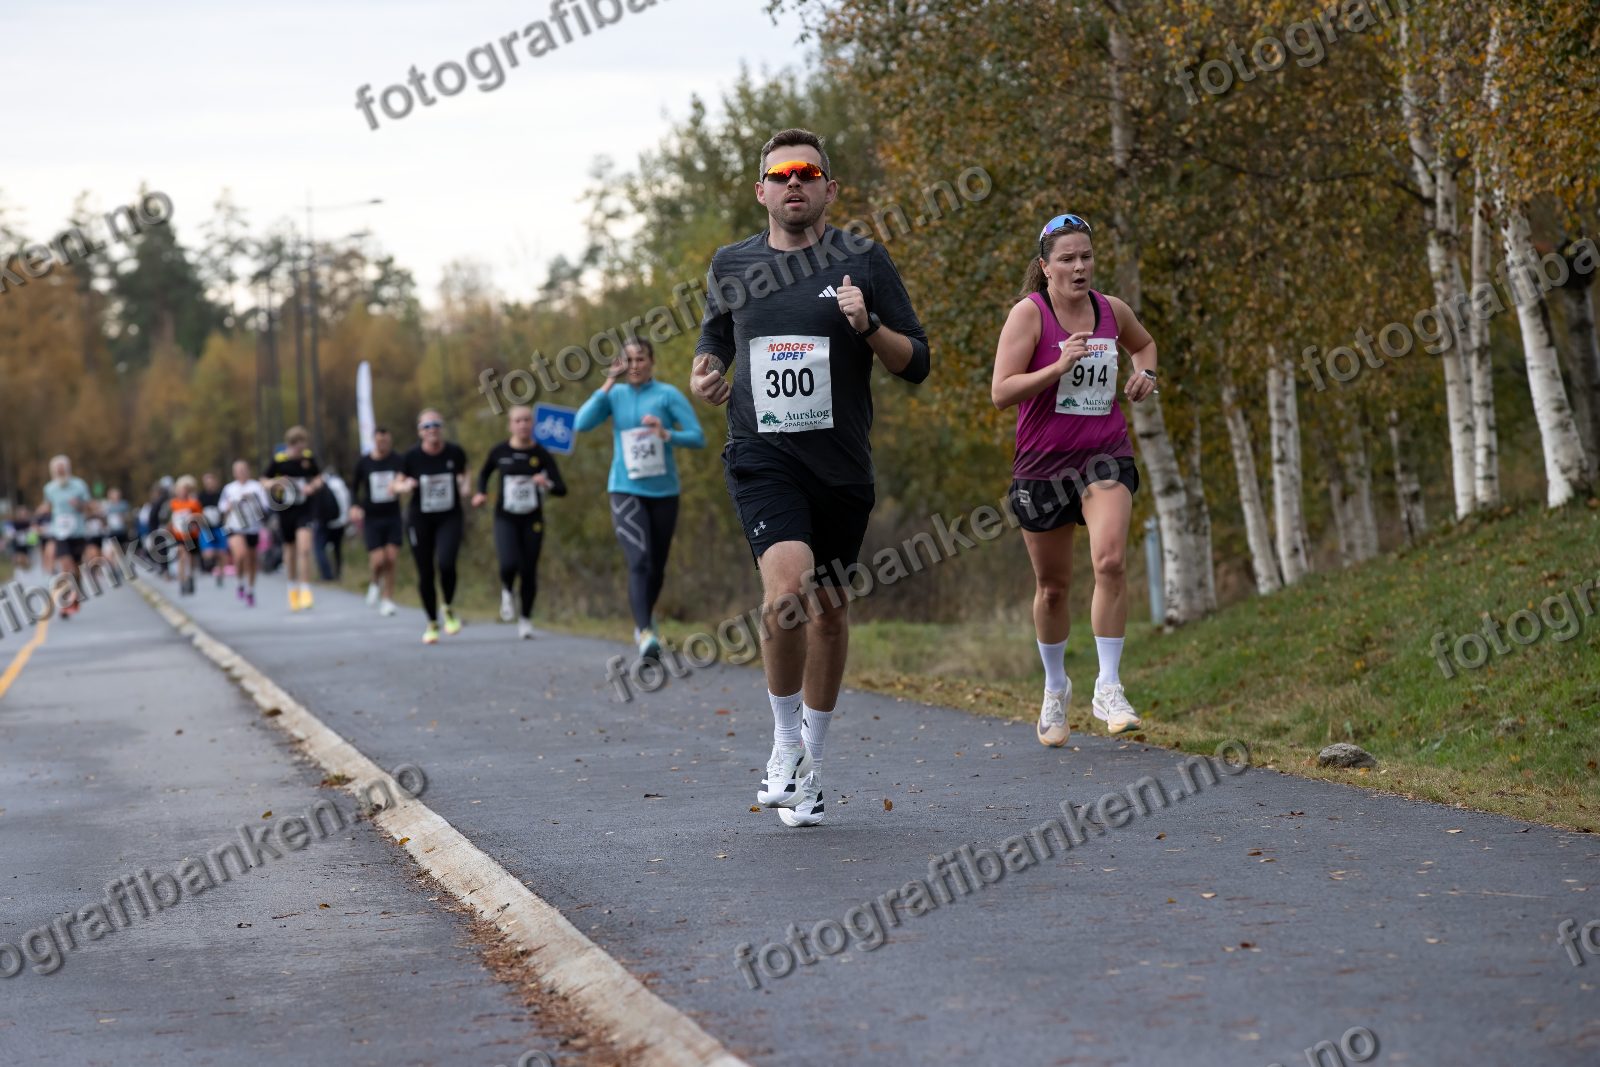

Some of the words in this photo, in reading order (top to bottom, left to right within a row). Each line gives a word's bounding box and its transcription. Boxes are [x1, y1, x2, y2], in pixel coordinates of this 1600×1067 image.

[767, 342, 815, 352] NORGES
[771, 351, 806, 361] LØPET
[1072, 364, 1108, 387] 914
[765, 367, 815, 398] 300
[784, 408, 830, 421] Aurskog
